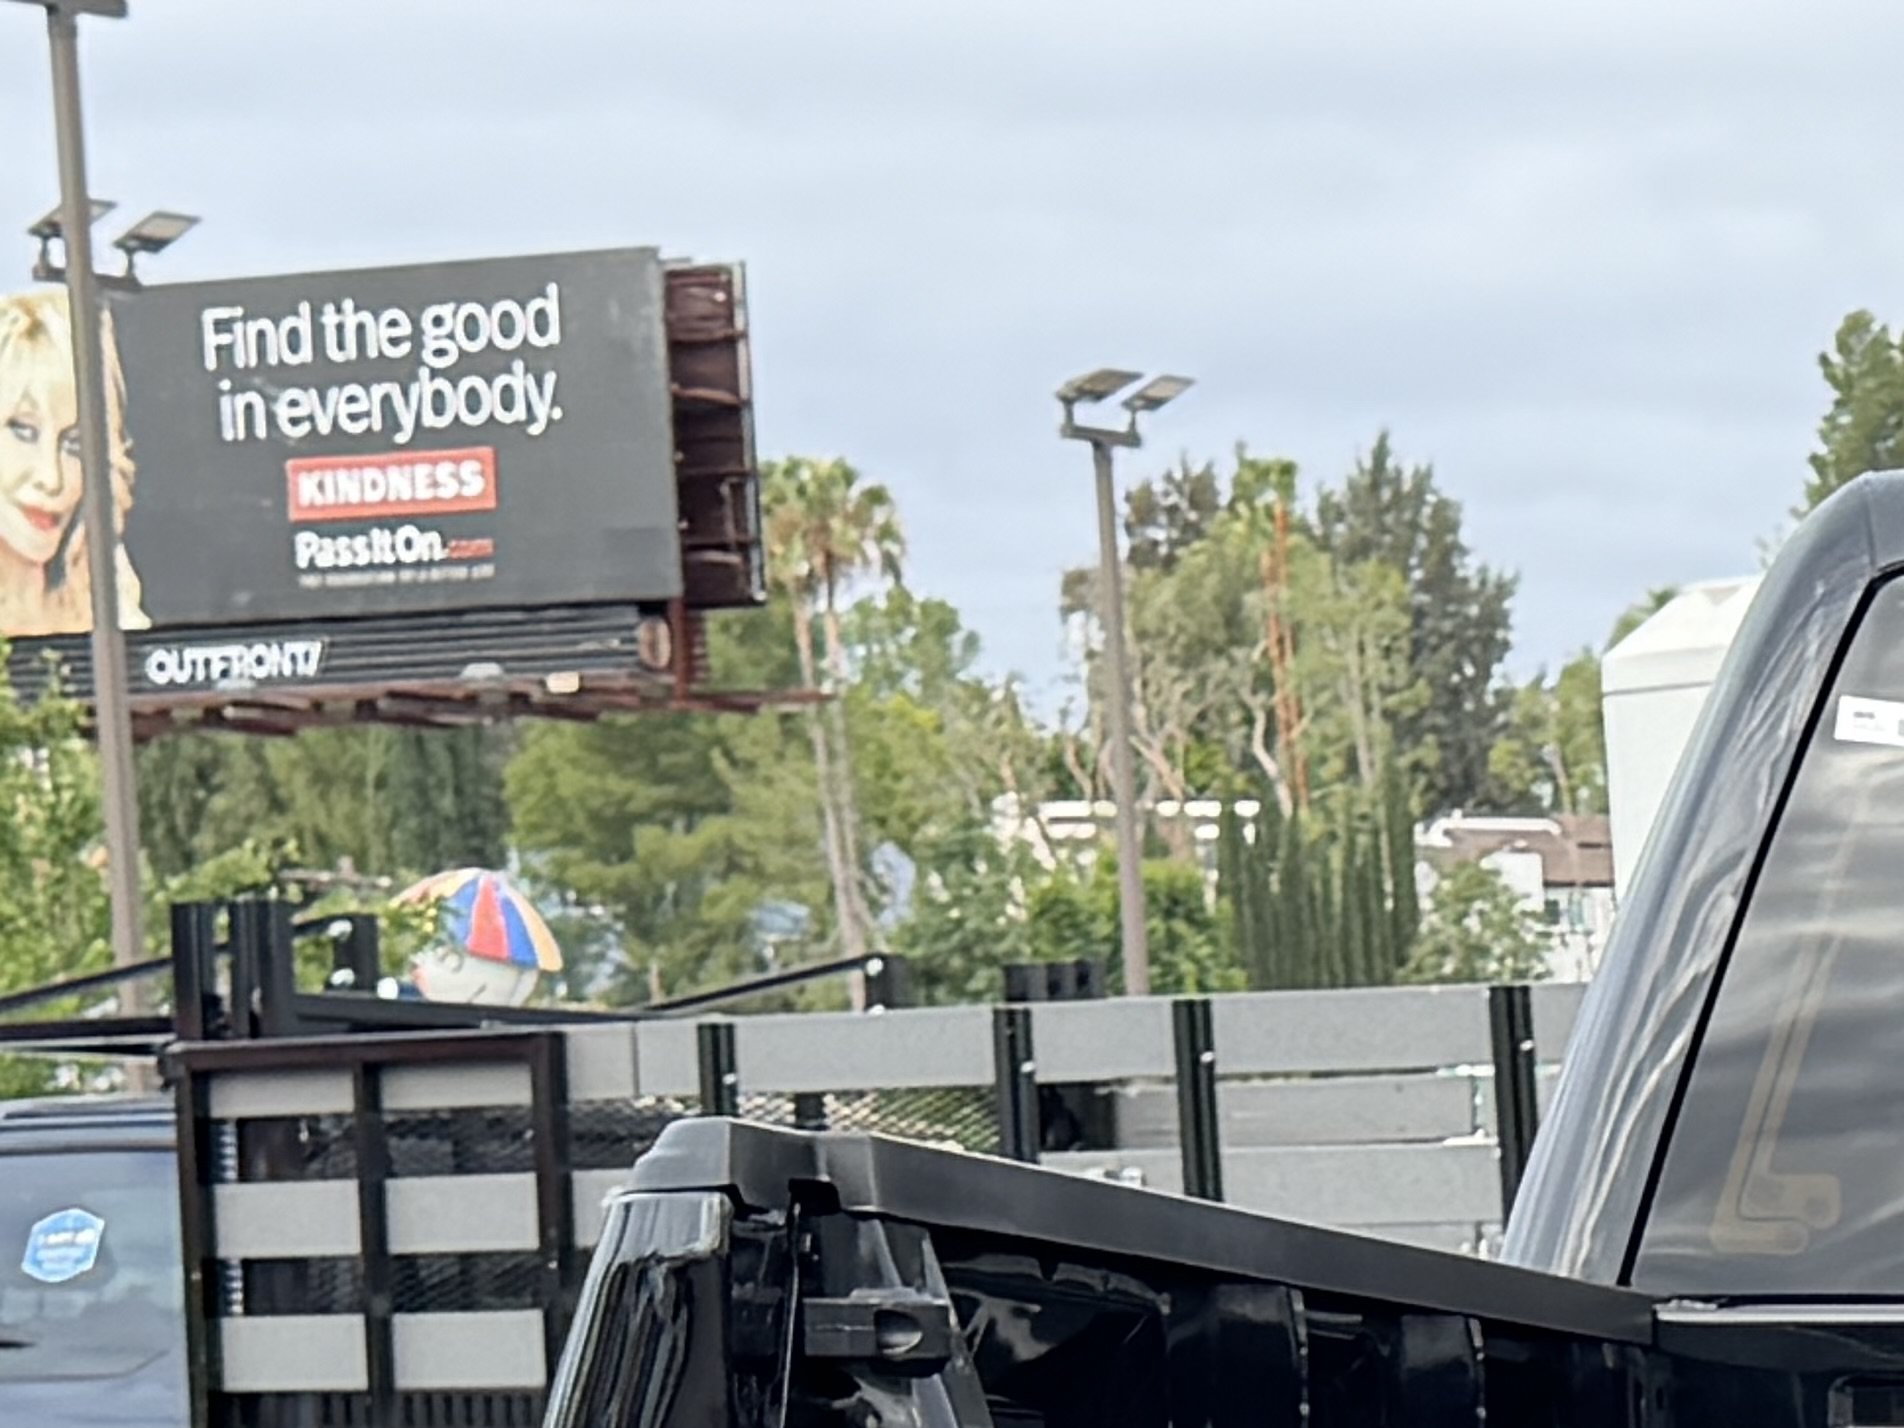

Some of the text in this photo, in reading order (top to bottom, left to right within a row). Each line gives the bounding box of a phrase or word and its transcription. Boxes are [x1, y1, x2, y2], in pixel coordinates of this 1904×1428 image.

[202, 282, 561, 370] Find the good
[217, 358, 563, 444] in everybody.
[297, 459, 485, 506] KINDNESS
